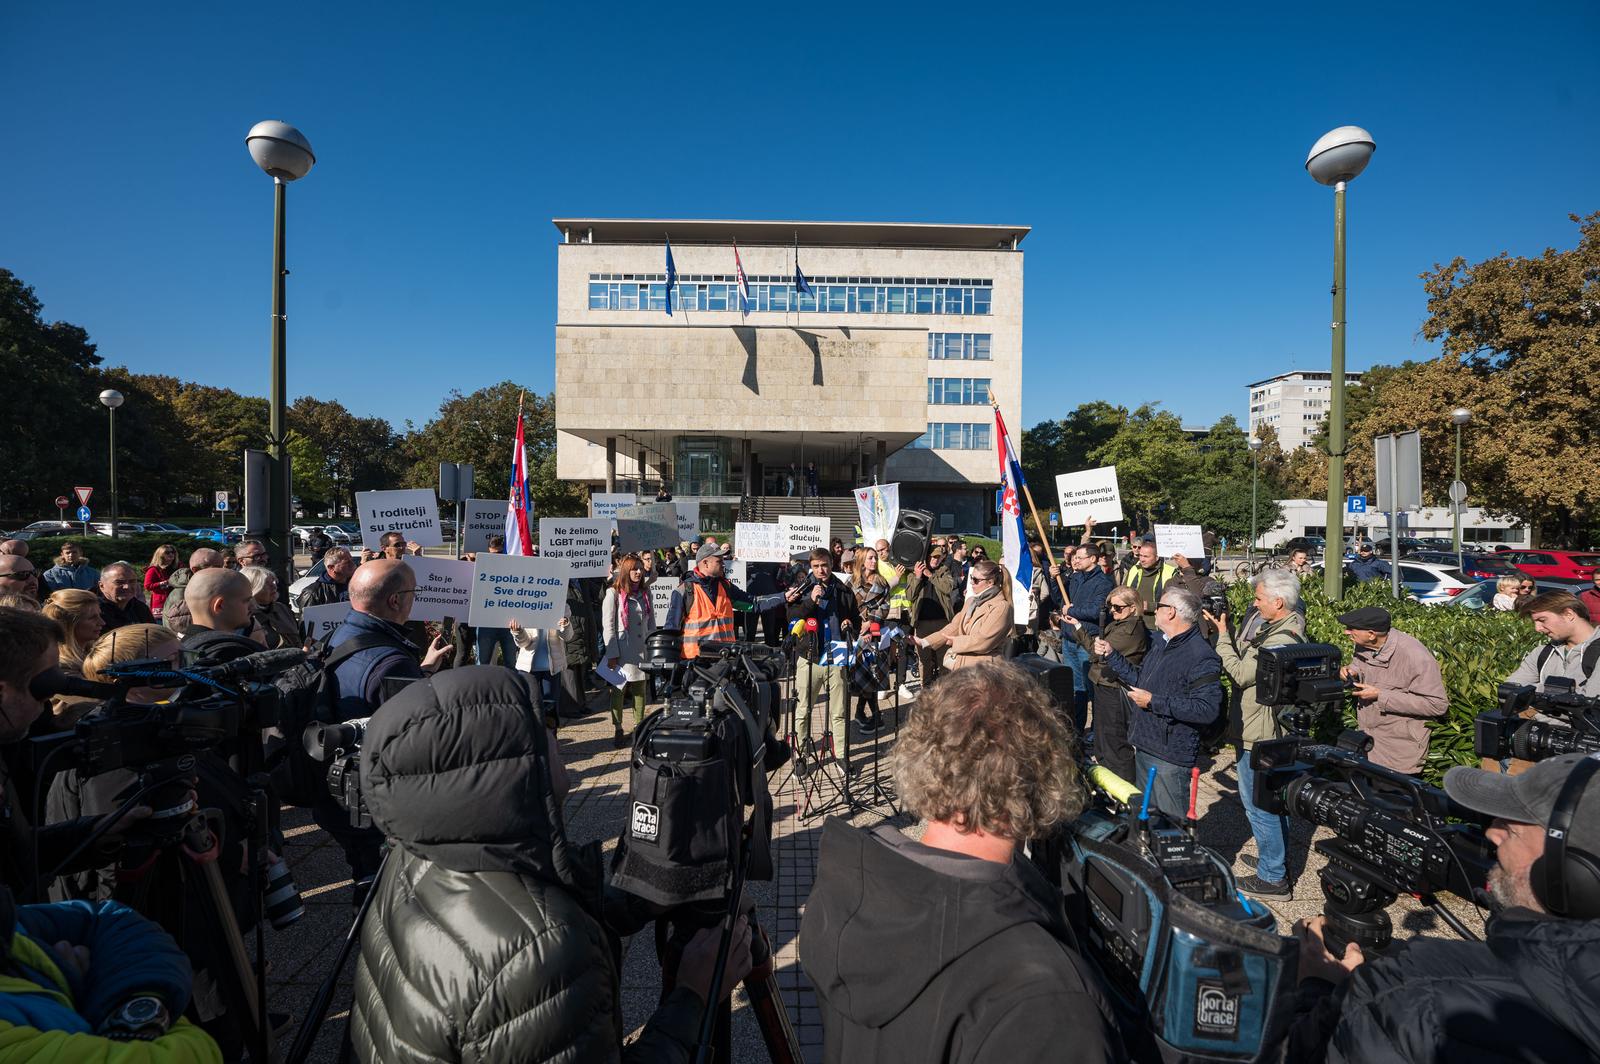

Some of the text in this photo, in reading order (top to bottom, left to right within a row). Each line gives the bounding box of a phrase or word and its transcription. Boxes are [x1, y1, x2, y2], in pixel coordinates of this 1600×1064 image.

[1074, 486, 1112, 497] rezbarenju
[1063, 495, 1116, 508] drvenih penisa!
[1353, 499, 1361, 510] P
[372, 506, 426, 518] I roditelji
[475, 512, 500, 520] STOP
[370, 519, 433, 532] su stručni!
[469, 522, 506, 530] seksuali
[554, 527, 598, 535] Ne želimo
[550, 538, 603, 547] LGBT mafiju
[789, 534, 822, 543] dlučuju,
[544, 550, 563, 558] koja
[566, 549, 587, 558] djeci
[428, 573, 444, 582] Što
[480, 573, 486, 581] 2
[489, 575, 519, 585] spola
[527, 576, 534, 584] 2
[537, 576, 563, 586] roda.
[422, 585, 467, 595] škarac bez
[494, 586, 547, 599] Sve drugo
[415, 595, 469, 605] kromosoma?
[484, 598, 553, 610] je ideologija!
[635, 811, 657, 824] porta
[1403, 828, 1430, 842] SONY
[1201, 996, 1234, 1012] porta
